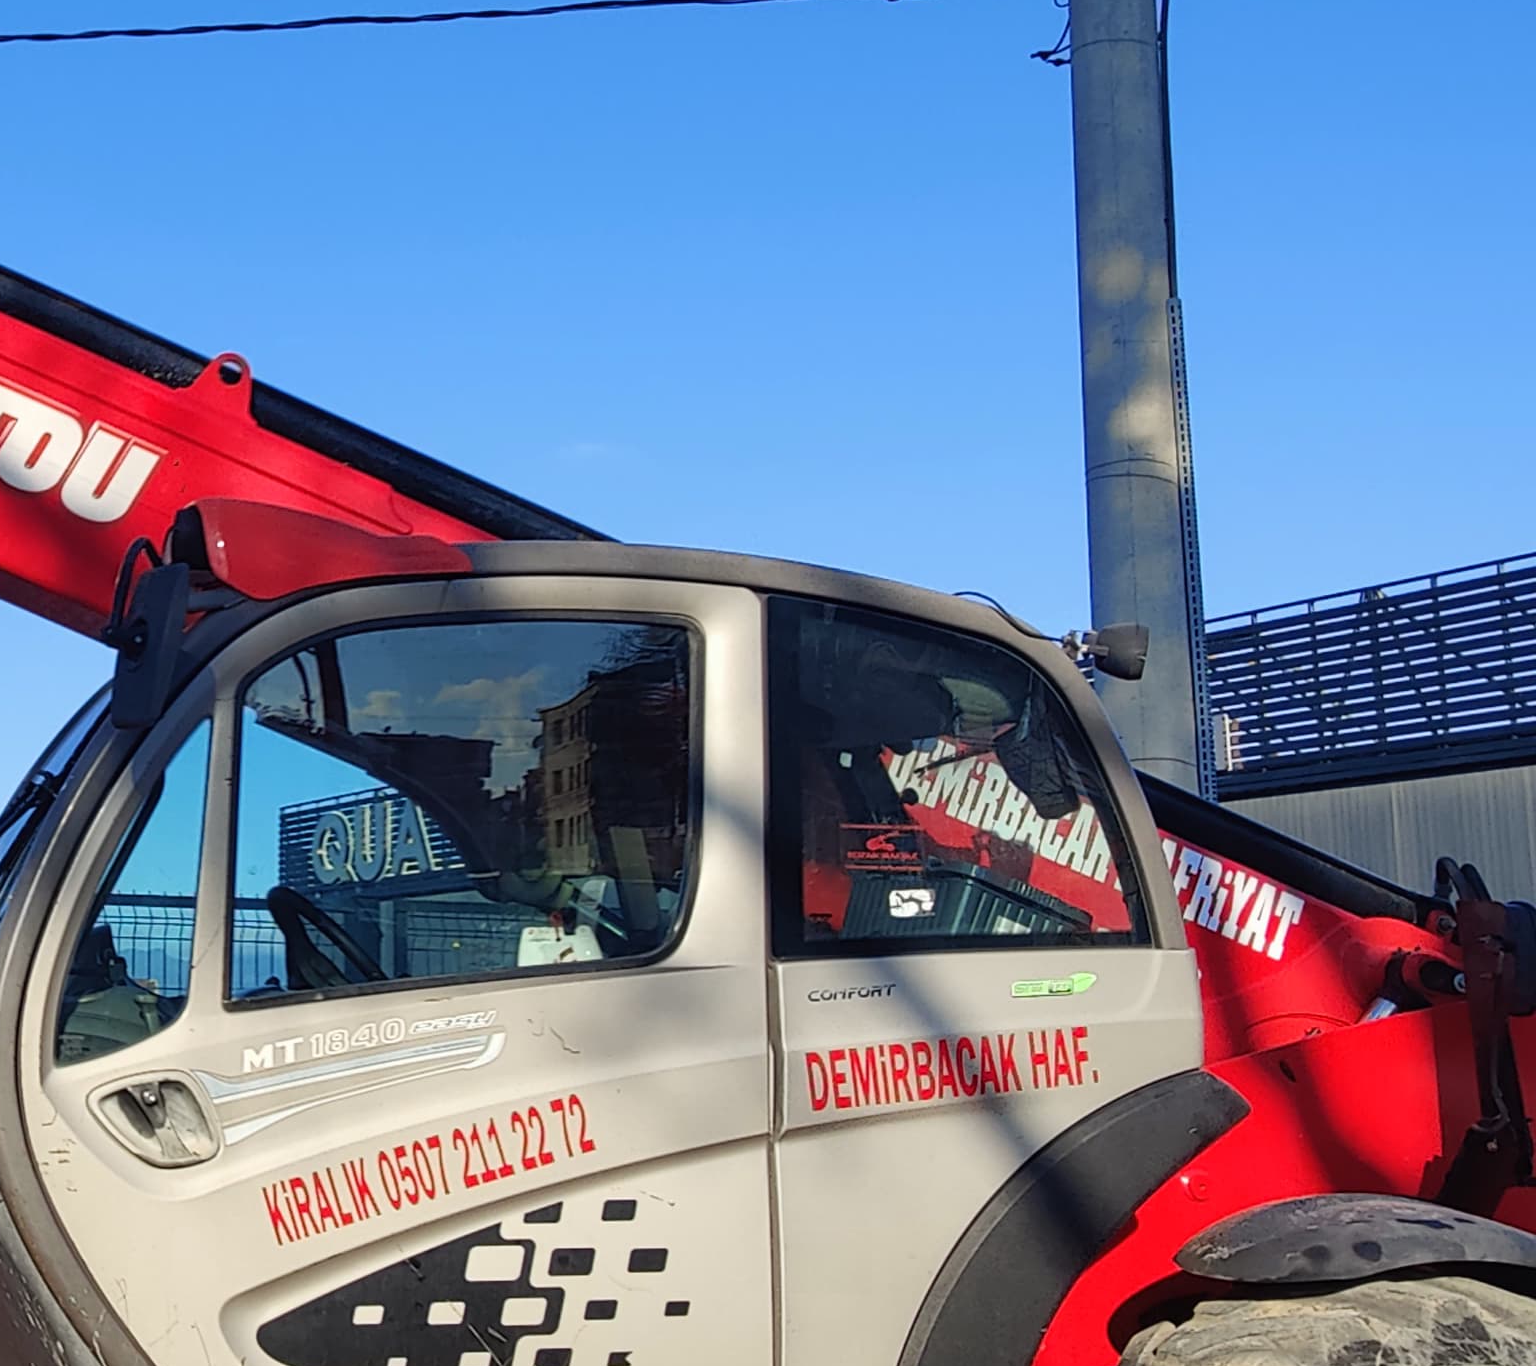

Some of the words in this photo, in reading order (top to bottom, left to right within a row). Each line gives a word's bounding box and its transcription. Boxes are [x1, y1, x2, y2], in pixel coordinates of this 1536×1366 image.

[807, 983, 897, 1003] COMFORT
[242, 1037, 304, 1073] MT
[309, 1018, 407, 1059] 1840
[1028, 1025, 1100, 1089] HAF.
[378, 1134, 450, 1211] 0507
[452, 1117, 515, 1188] 211
[510, 1106, 555, 1171] 22
[550, 1094, 597, 1158] 72
